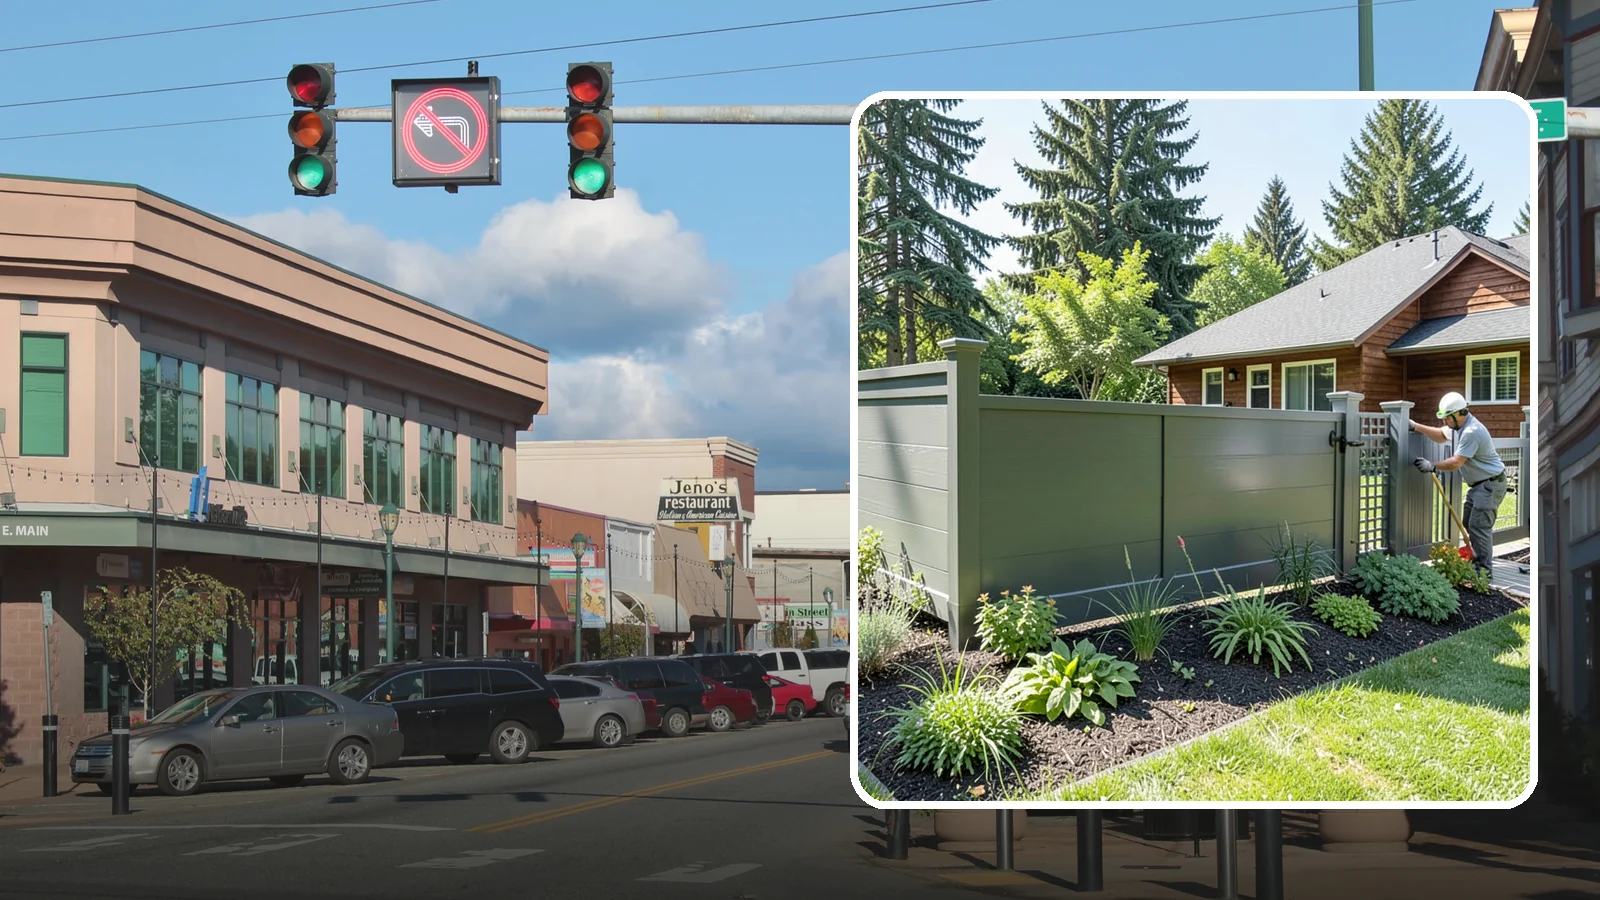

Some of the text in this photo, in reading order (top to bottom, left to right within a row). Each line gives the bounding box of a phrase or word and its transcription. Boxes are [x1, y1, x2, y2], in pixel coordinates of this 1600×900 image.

[670, 480, 727, 494] Jeno's
[665, 496, 731, 509] restaurant
[658, 509, 681, 519] Italian
[686, 509, 714, 519] American
[715, 509, 736, 519] Cuisine
[2, 525, 49, 536] E. MAIN
[797, 607, 828, 617] Street
[791, 619, 824, 627] lass
